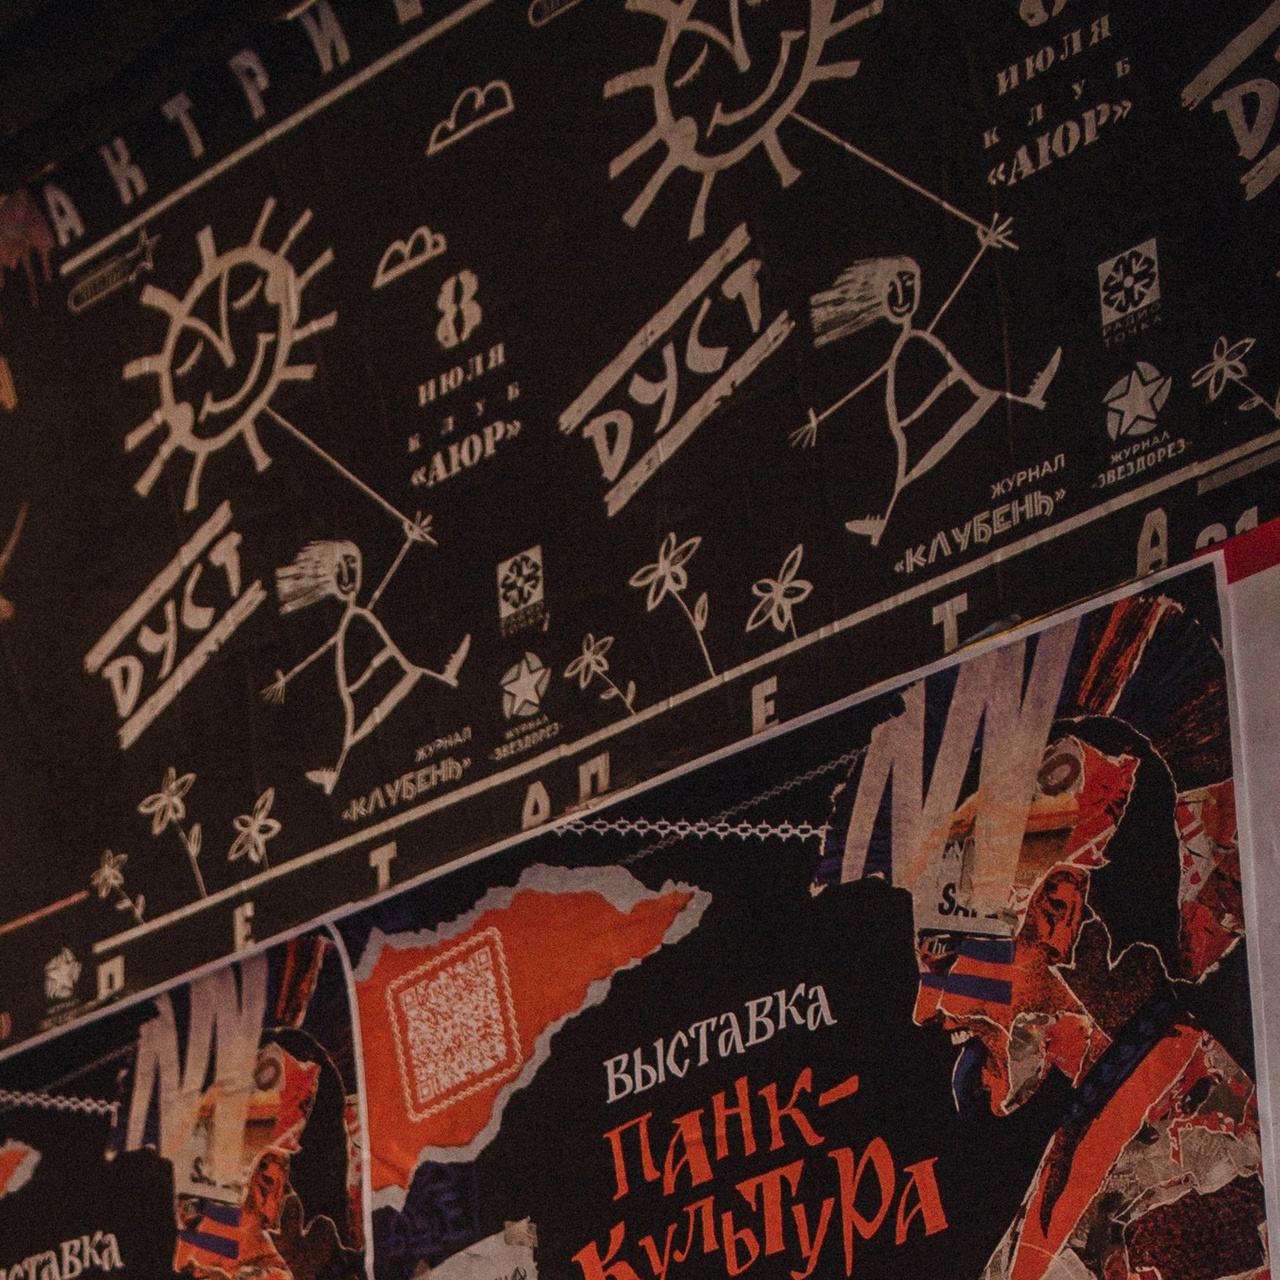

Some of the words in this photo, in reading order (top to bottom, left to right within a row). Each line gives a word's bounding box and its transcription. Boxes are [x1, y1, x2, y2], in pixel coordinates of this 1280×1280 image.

[436, 268, 483, 349] 8
[991, 452, 1066, 500] ЖУРНАЛ
[602, 1066, 861, 1201] ПАНК-
